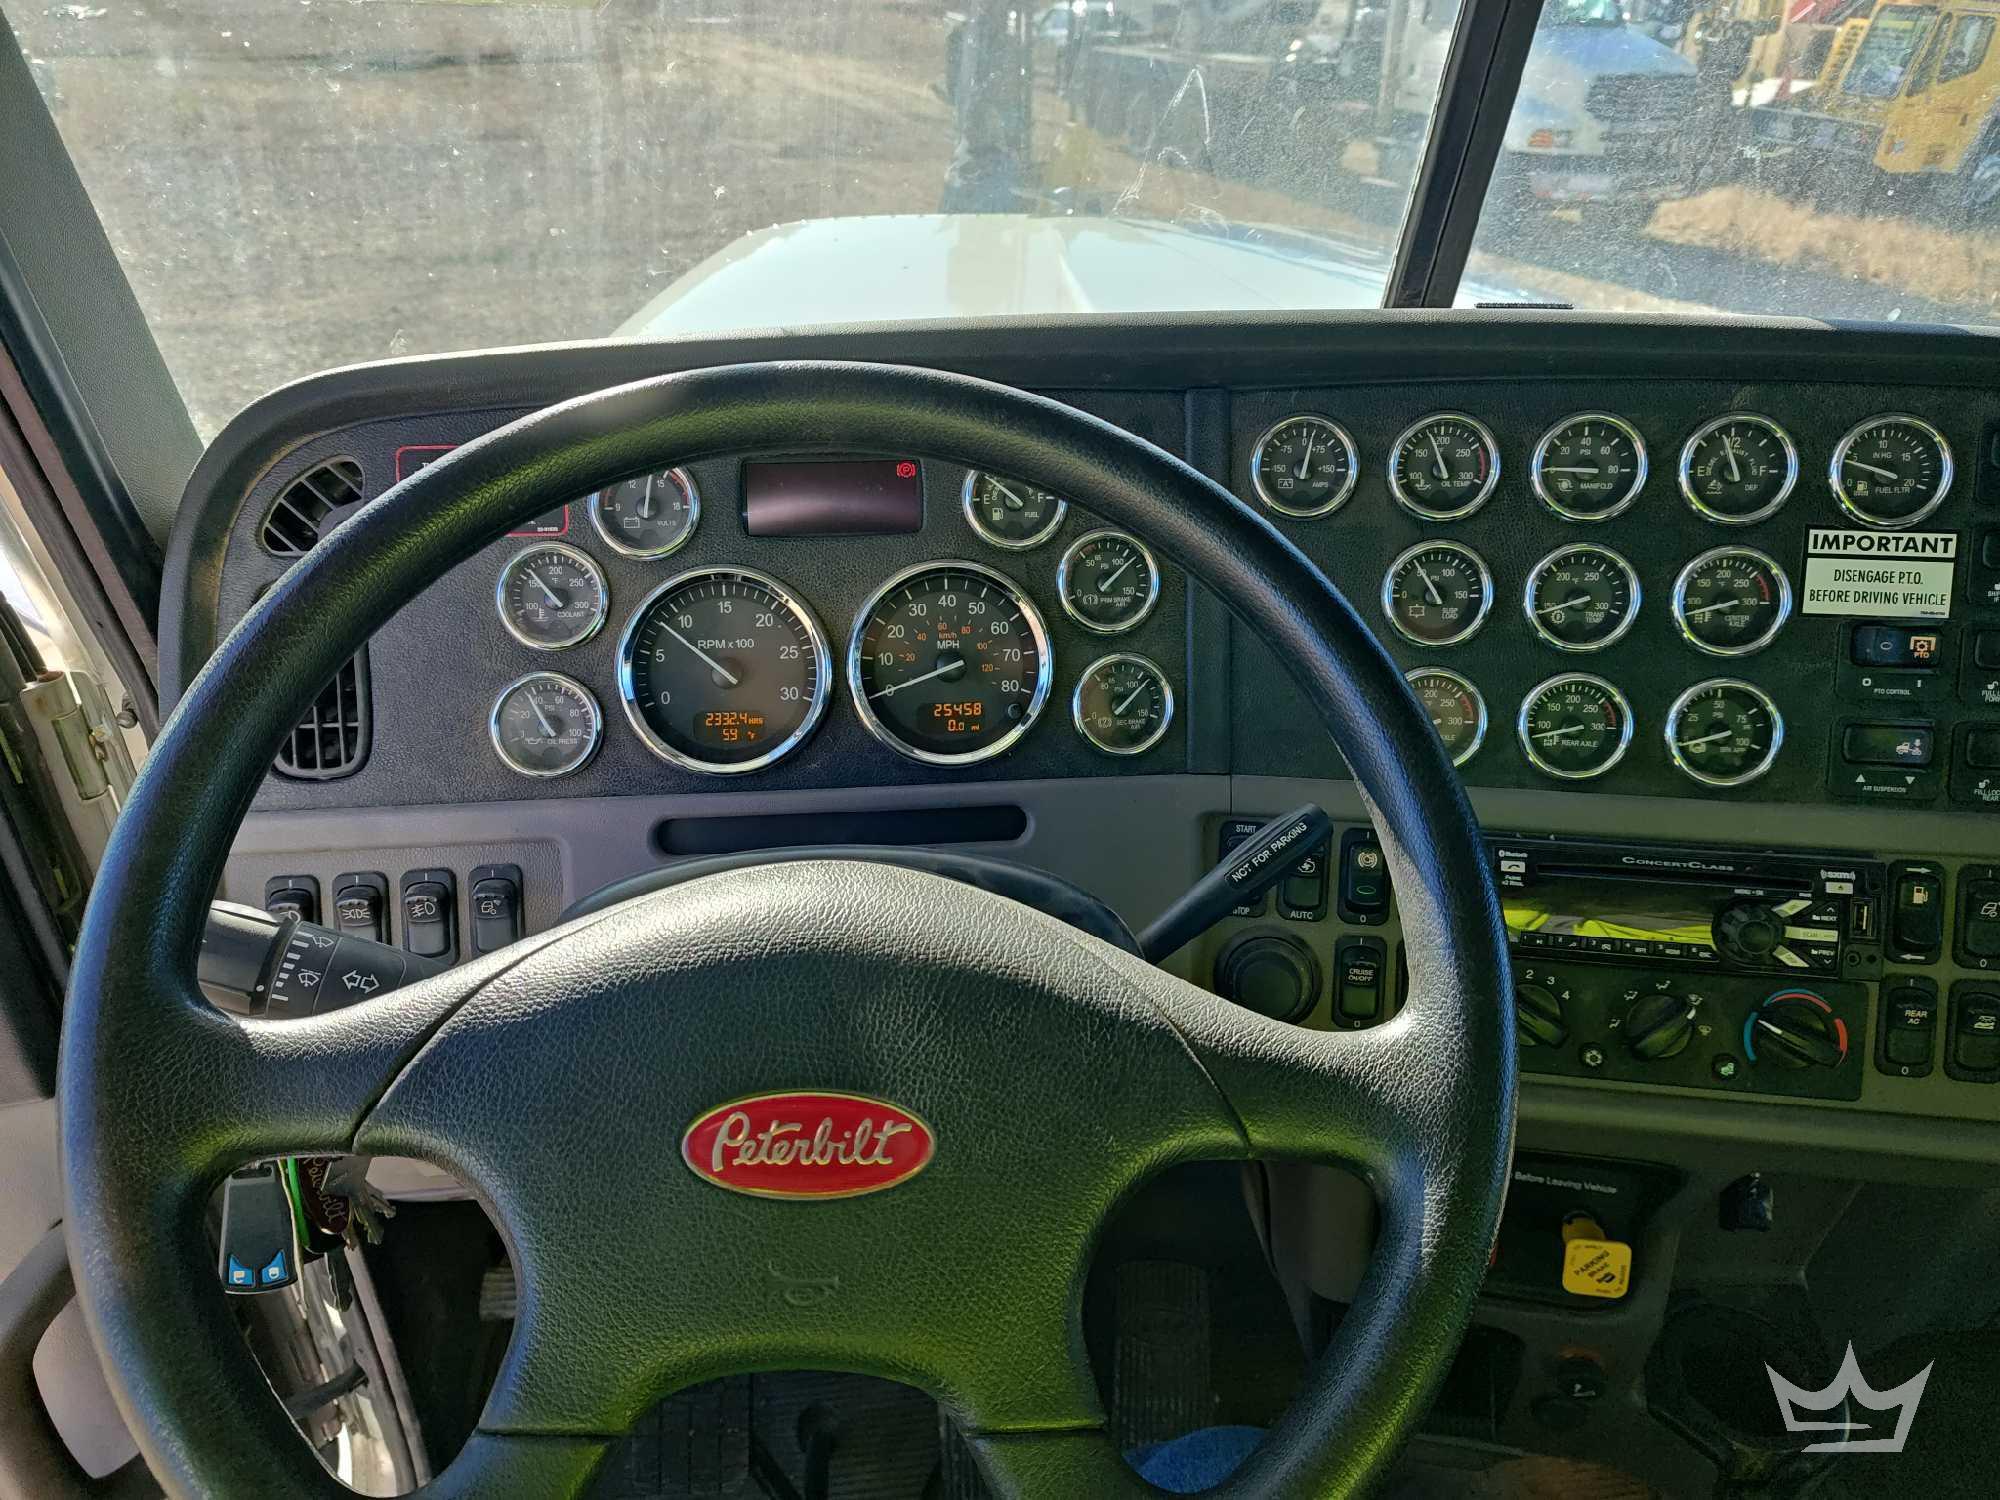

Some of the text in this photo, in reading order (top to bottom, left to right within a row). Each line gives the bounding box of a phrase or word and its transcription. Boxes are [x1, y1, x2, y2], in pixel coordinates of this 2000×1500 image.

[1581, 437, 1591, 446] 40
[1879, 440, 1887, 448] 10
[1415, 449, 1428, 457] 150
[1456, 449, 1470, 457] 250
[1902, 453, 1911, 461] 15
[1608, 465, 1618, 473] 80
[1698, 466, 1705, 476] E
[1760, 466, 1766, 476] F
[1458, 472, 1473, 480] 300
[657, 480, 664, 488] 15
[984, 494, 990, 504] E
[1038, 493, 1044, 503] F
[616, 503, 620, 511] 9
[1813, 534, 1953, 553] IMPORTANT
[1584, 572, 1599, 580] 250
[1716, 570, 1731, 578] 200
[1834, 569, 1923, 585] DISENGAGE P.T.O.
[569, 579, 583, 587] 250
[1697, 579, 1711, 587] 150
[1734, 579, 1750, 587] 250
[1122, 587, 1134, 595] 150
[938, 595, 957, 607] 40
[1809, 590, 1947, 605] BEFORE DRIVING VEHICLE
[718, 602, 732, 614] 15
[909, 604, 927, 616] 30
[968, 602, 985, 615] 50
[678, 616, 693, 628] 10
[756, 614, 774, 627] 20
[887, 625, 904, 638] 20
[991, 622, 1009, 634] 60
[698, 640, 726, 649] RPM
[937, 640, 960, 649] MPH
[655, 650, 665, 662] 5
[780, 647, 798, 659] 25
[1003, 649, 1020, 661] 70
[878, 653, 893, 665] 10
[982, 664, 993, 672] 120
[1001, 680, 1019, 692] 80
[661, 692, 670, 704] 0
[780, 688, 799, 700] 30
[1440, 699, 1455, 707] 250
[1566, 695, 1580, 703] 200
[934, 703, 982, 717] 25458
[1547, 703, 1560, 711] 150
[1583, 705, 1598, 713] 250
[705, 713, 747, 726] 2332.4
[1448, 717, 1462, 725] 300
[1538, 721, 1551, 729] 100
[569, 729, 581, 737] 100
[1236, 825, 1256, 833] START
[1231, 822, 1308, 883] NOT FOR PARKING
[1290, 911, 1313, 919] AUTO
[1349, 968, 1374, 976] CRUISE
[1526, 970, 1534, 980] 2
[1547, 976, 1555, 985] 3
[1561, 990, 1570, 1000] 4
[712, 1111, 912, 1172] Peterbilt
